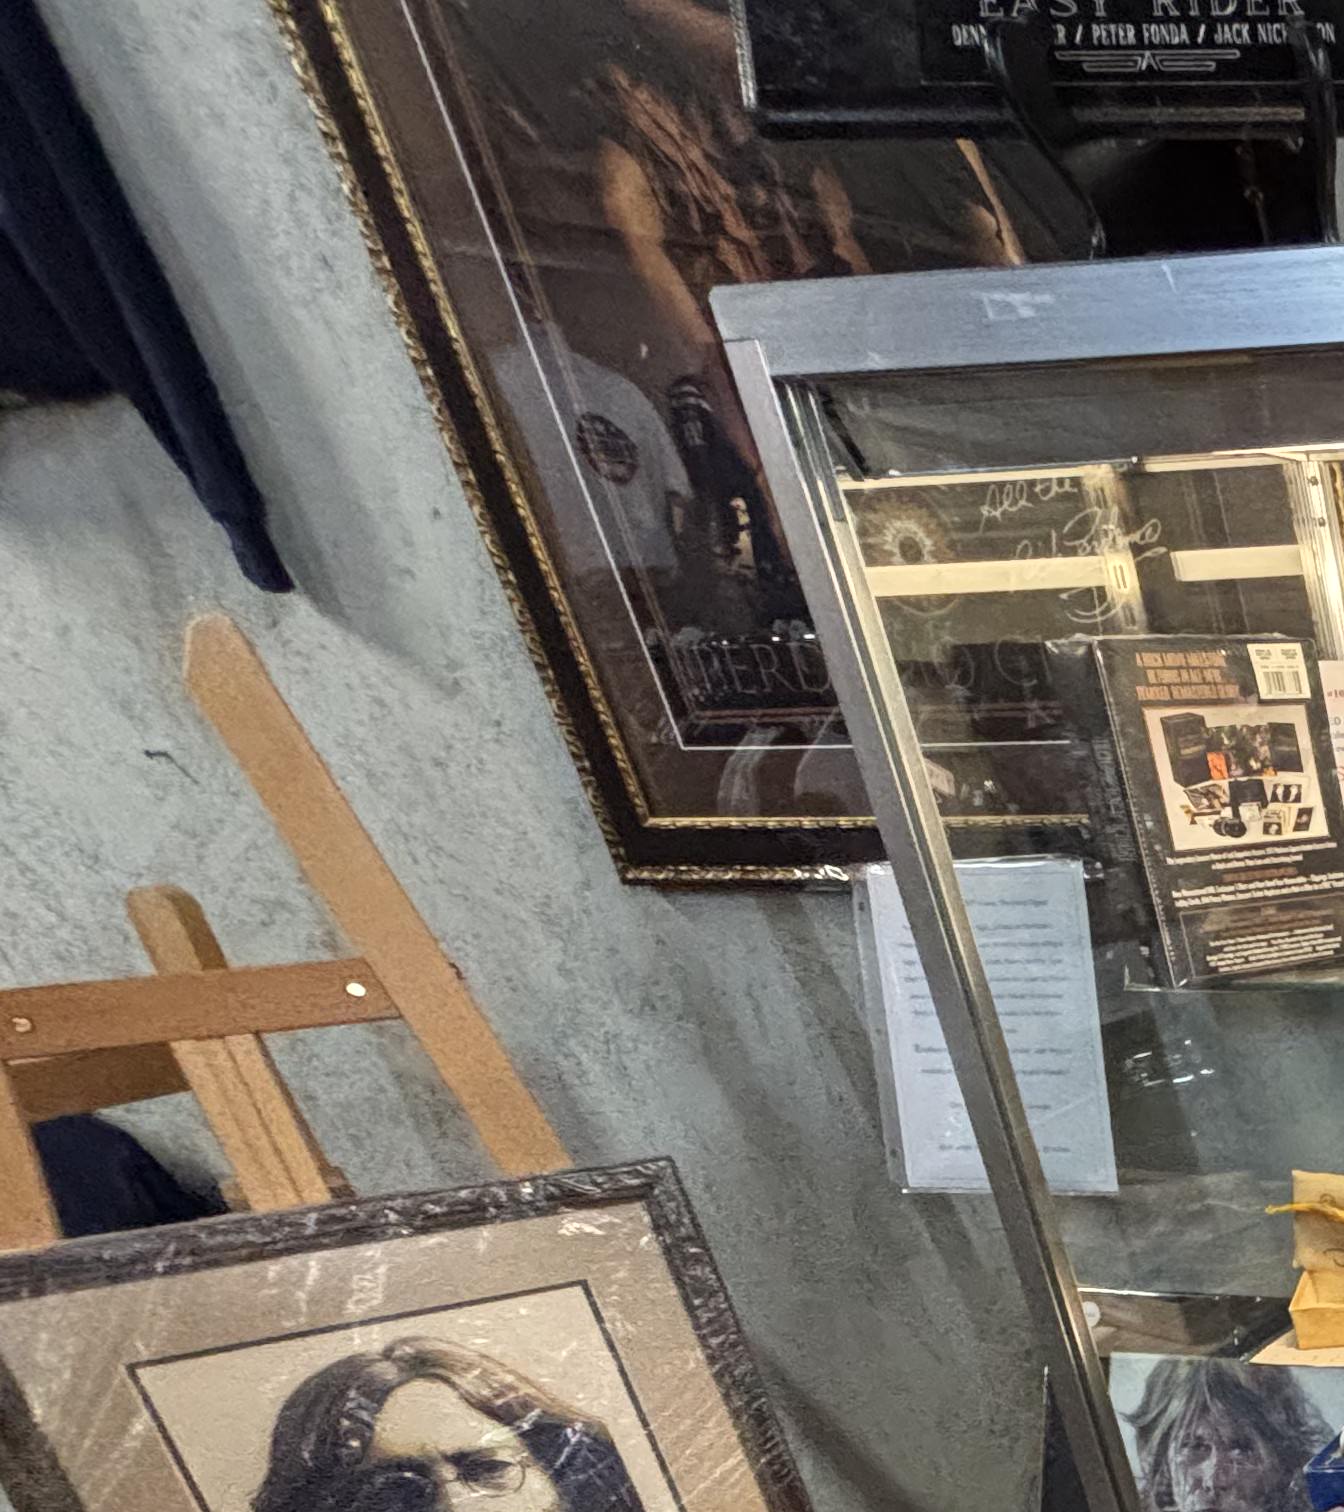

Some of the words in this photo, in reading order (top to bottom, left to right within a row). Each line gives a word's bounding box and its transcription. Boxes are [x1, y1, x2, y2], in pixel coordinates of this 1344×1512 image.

[1092, 22, 1135, 46] PETER
[1142, 22, 1188, 46] FONDA
[1214, 22, 1250, 46] JACK
